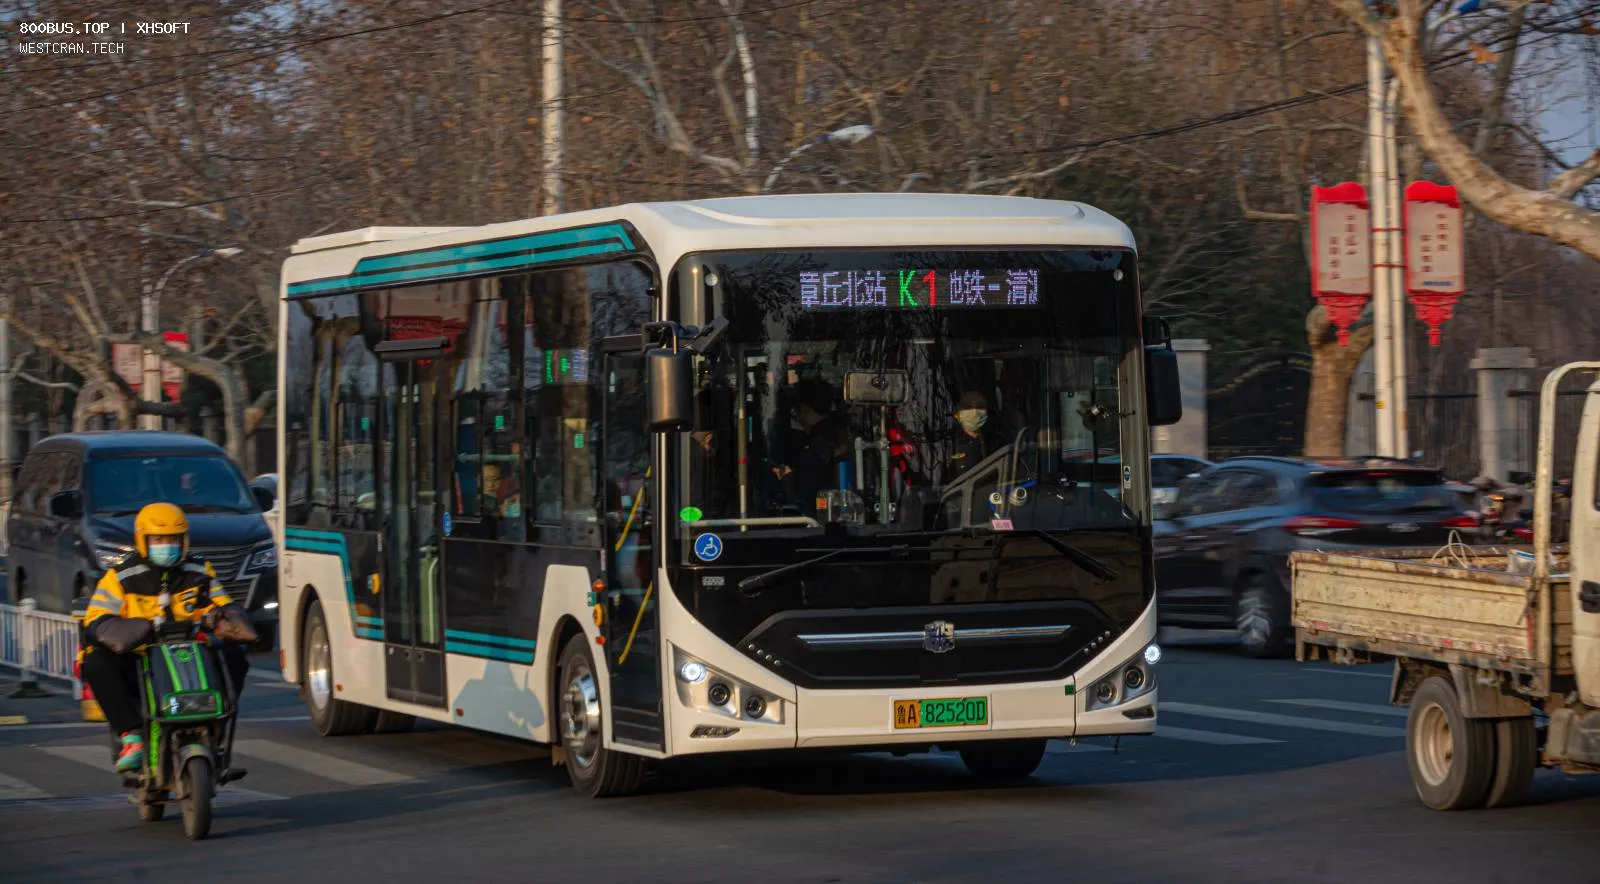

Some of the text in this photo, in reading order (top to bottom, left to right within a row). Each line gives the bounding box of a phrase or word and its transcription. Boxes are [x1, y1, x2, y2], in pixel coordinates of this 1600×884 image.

[799, 270, 887, 308] 章丘北站
[899, 269, 937, 307] K1
